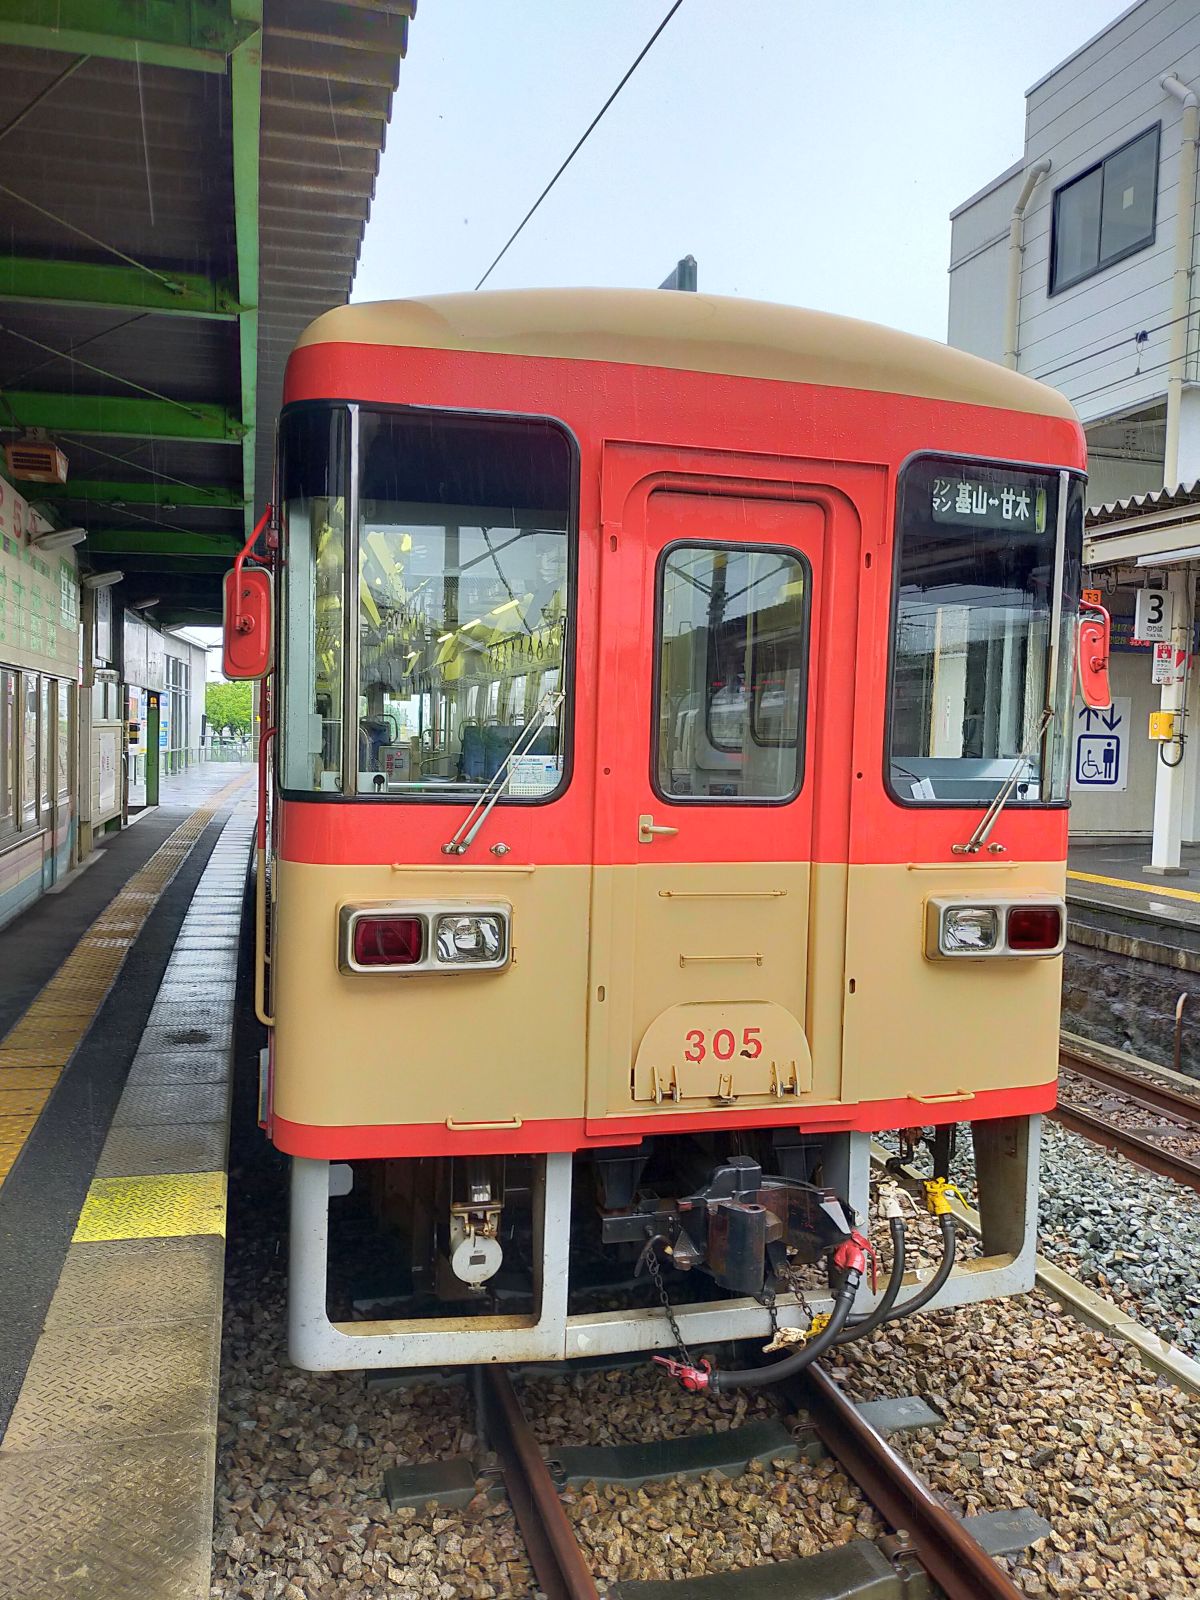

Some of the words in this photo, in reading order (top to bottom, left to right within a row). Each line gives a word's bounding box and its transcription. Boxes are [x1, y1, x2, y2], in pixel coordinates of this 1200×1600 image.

[955, 482, 988, 514] 基山
[1000, 487, 1031, 520] 甘木
[1147, 594, 1164, 624] 3
[684, 1027, 763, 1062] 305
